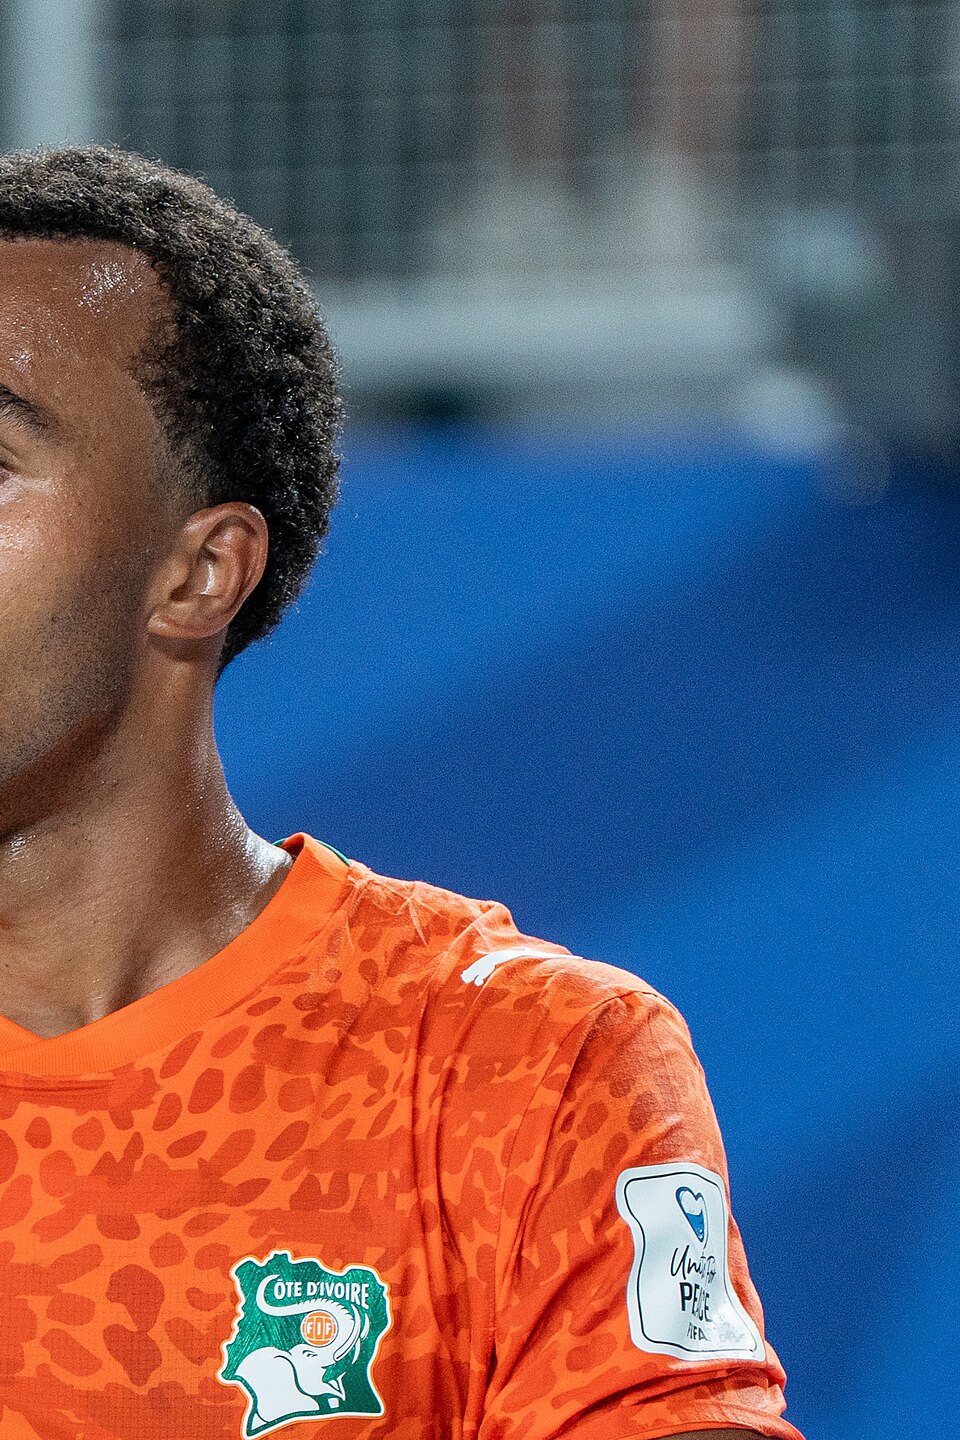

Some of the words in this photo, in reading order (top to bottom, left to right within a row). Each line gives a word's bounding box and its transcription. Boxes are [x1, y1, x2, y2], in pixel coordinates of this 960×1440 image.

[670, 1244, 706, 1280] Unit
[306, 1281, 370, 1310] D'IVOIRE
[306, 1321, 332, 1336] FIF
